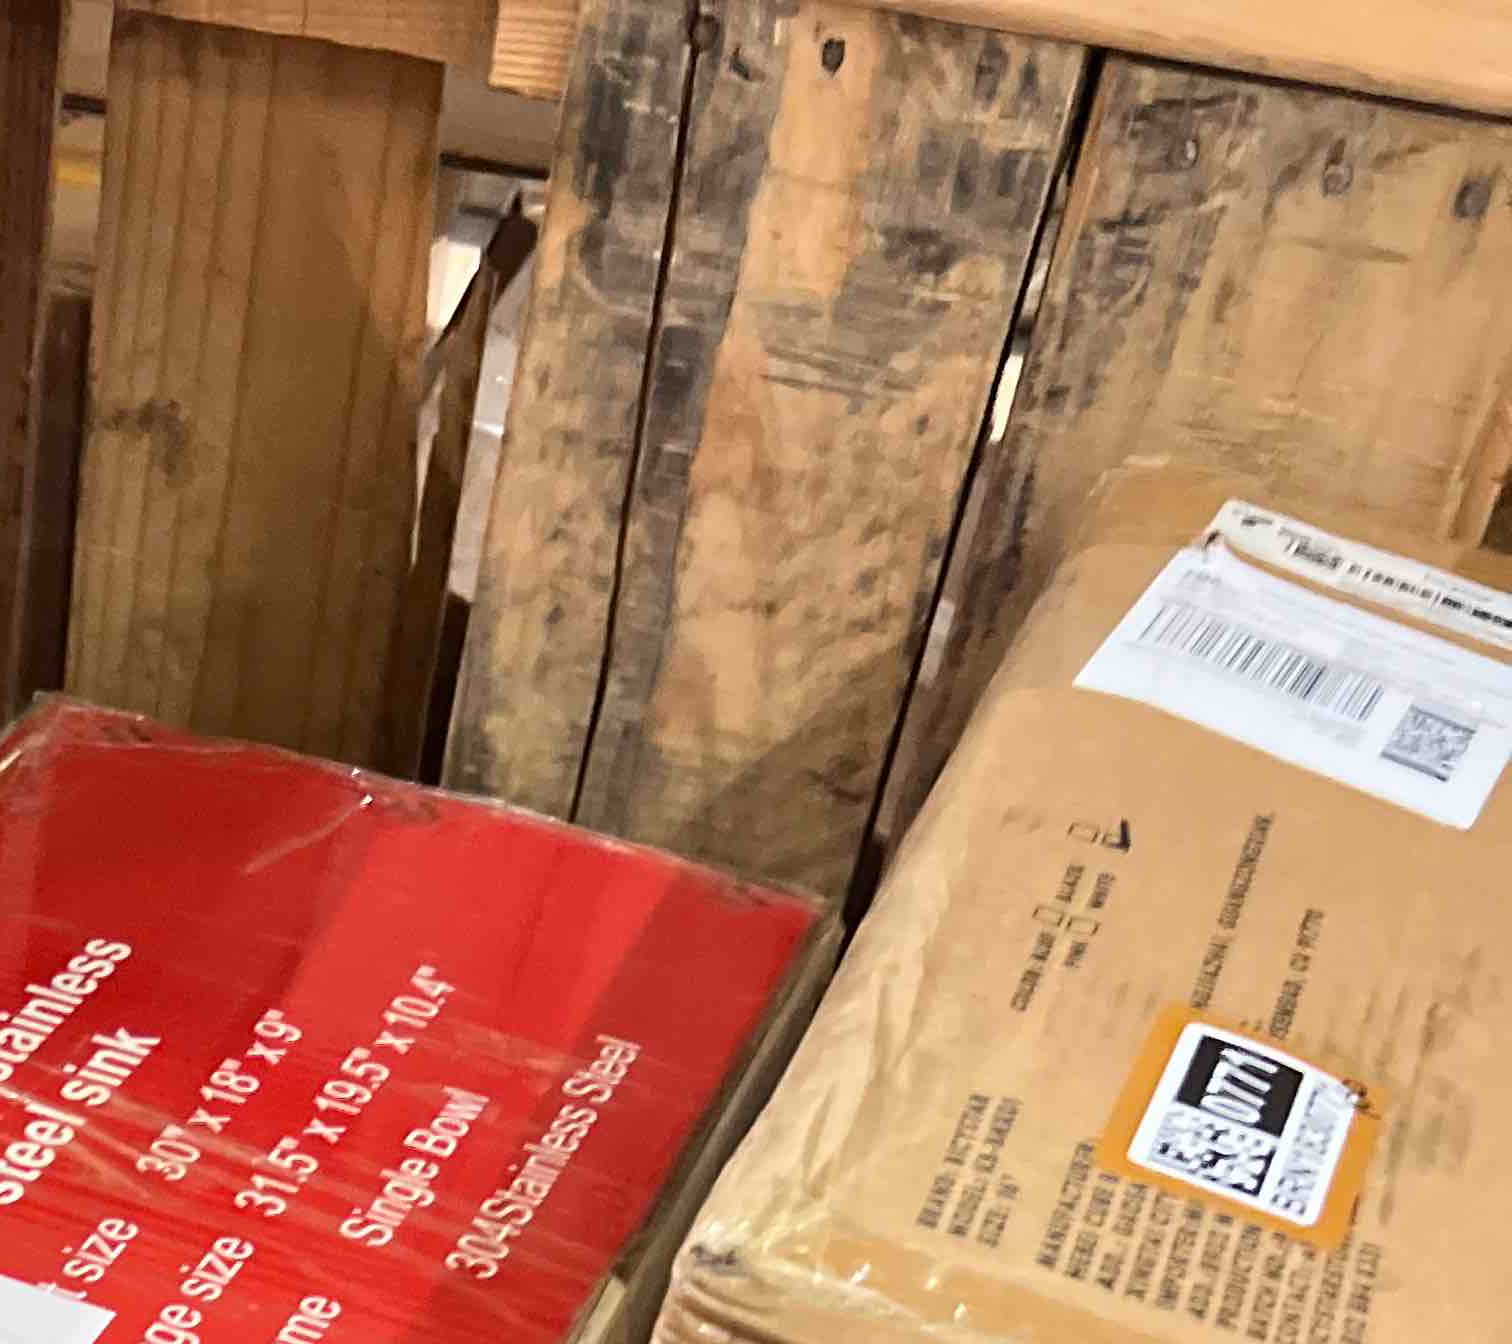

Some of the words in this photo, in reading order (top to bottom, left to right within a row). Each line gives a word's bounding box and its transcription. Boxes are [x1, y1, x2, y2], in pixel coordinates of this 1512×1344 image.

[59, 1026, 163, 1109] sink
[562, 1032, 644, 1106] Steel
[1199, 1047, 1279, 1125] 0771
[337, 1152, 443, 1249] Single
[403, 1084, 492, 1160] Bowl
[61, 1215, 141, 1288] size
[179, 1234, 256, 1304] size
